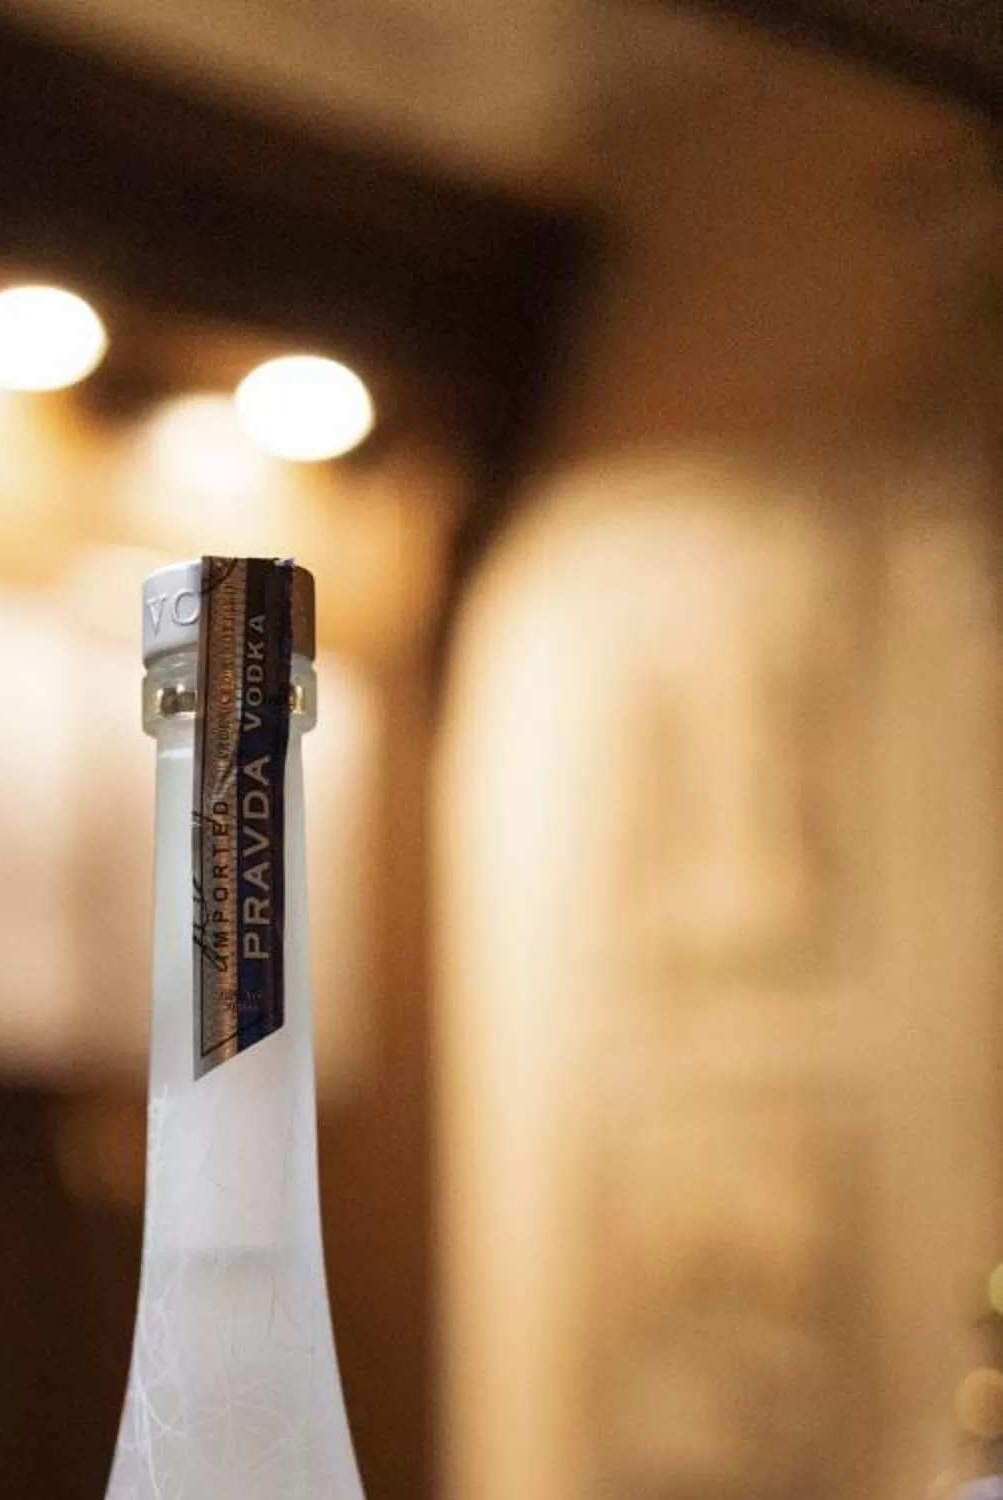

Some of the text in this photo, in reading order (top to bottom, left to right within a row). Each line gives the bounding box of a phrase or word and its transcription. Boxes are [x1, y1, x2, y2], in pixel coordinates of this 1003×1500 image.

[212, 801, 230, 960] IMPORTED
[243, 613, 271, 960] PRAVDA VODKA
